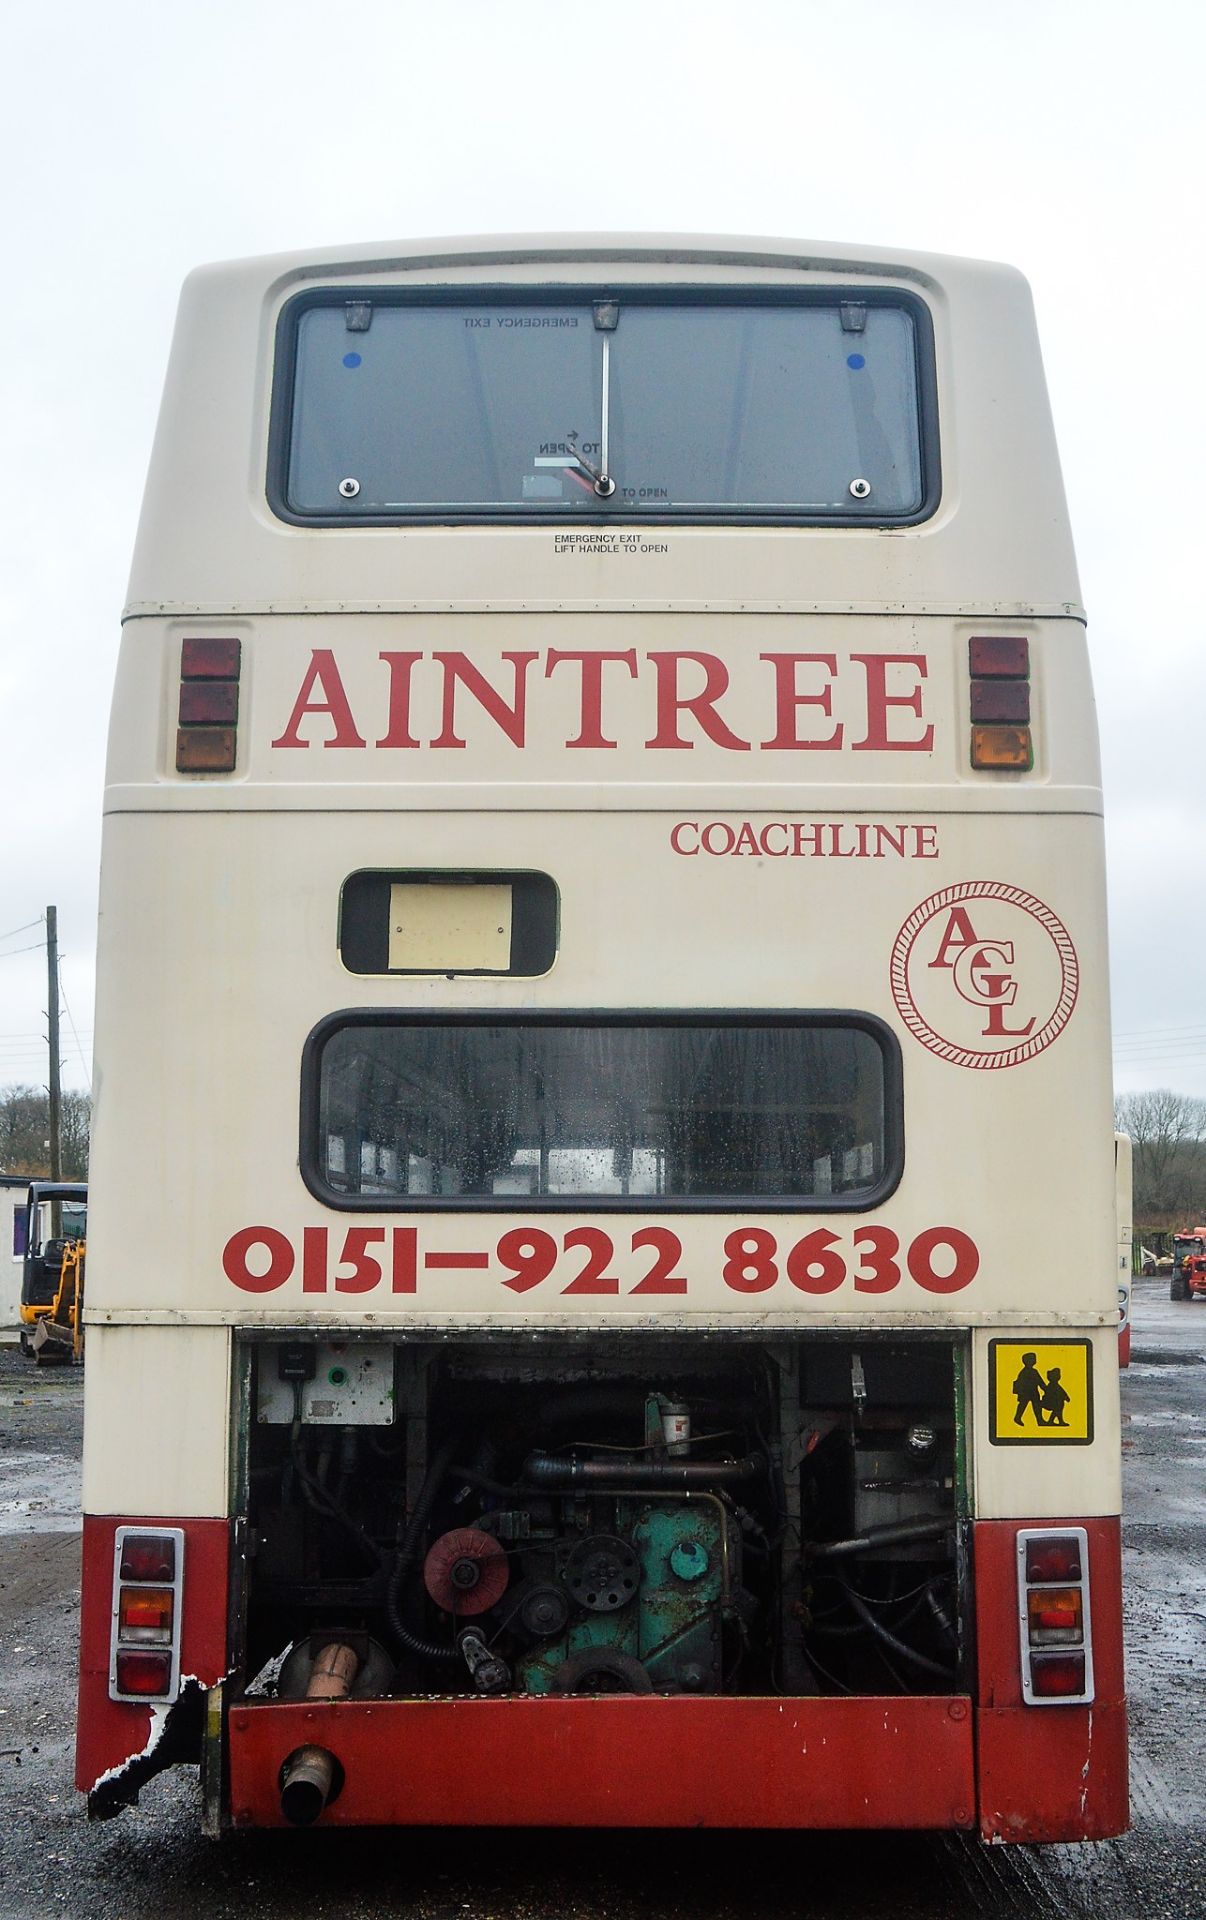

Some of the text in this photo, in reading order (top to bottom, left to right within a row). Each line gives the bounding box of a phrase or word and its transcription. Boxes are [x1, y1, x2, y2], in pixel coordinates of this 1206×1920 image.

[622, 488, 668, 498] TO OPEN
[554, 535, 642, 543] EMERGENCY EXIT
[554, 545, 668, 553] LIFT HANDLE TO OPEN
[271, 647, 934, 752] AINTREE
[670, 821, 940, 859] COACHLINE
[722, 1225, 981, 1295] 8630
